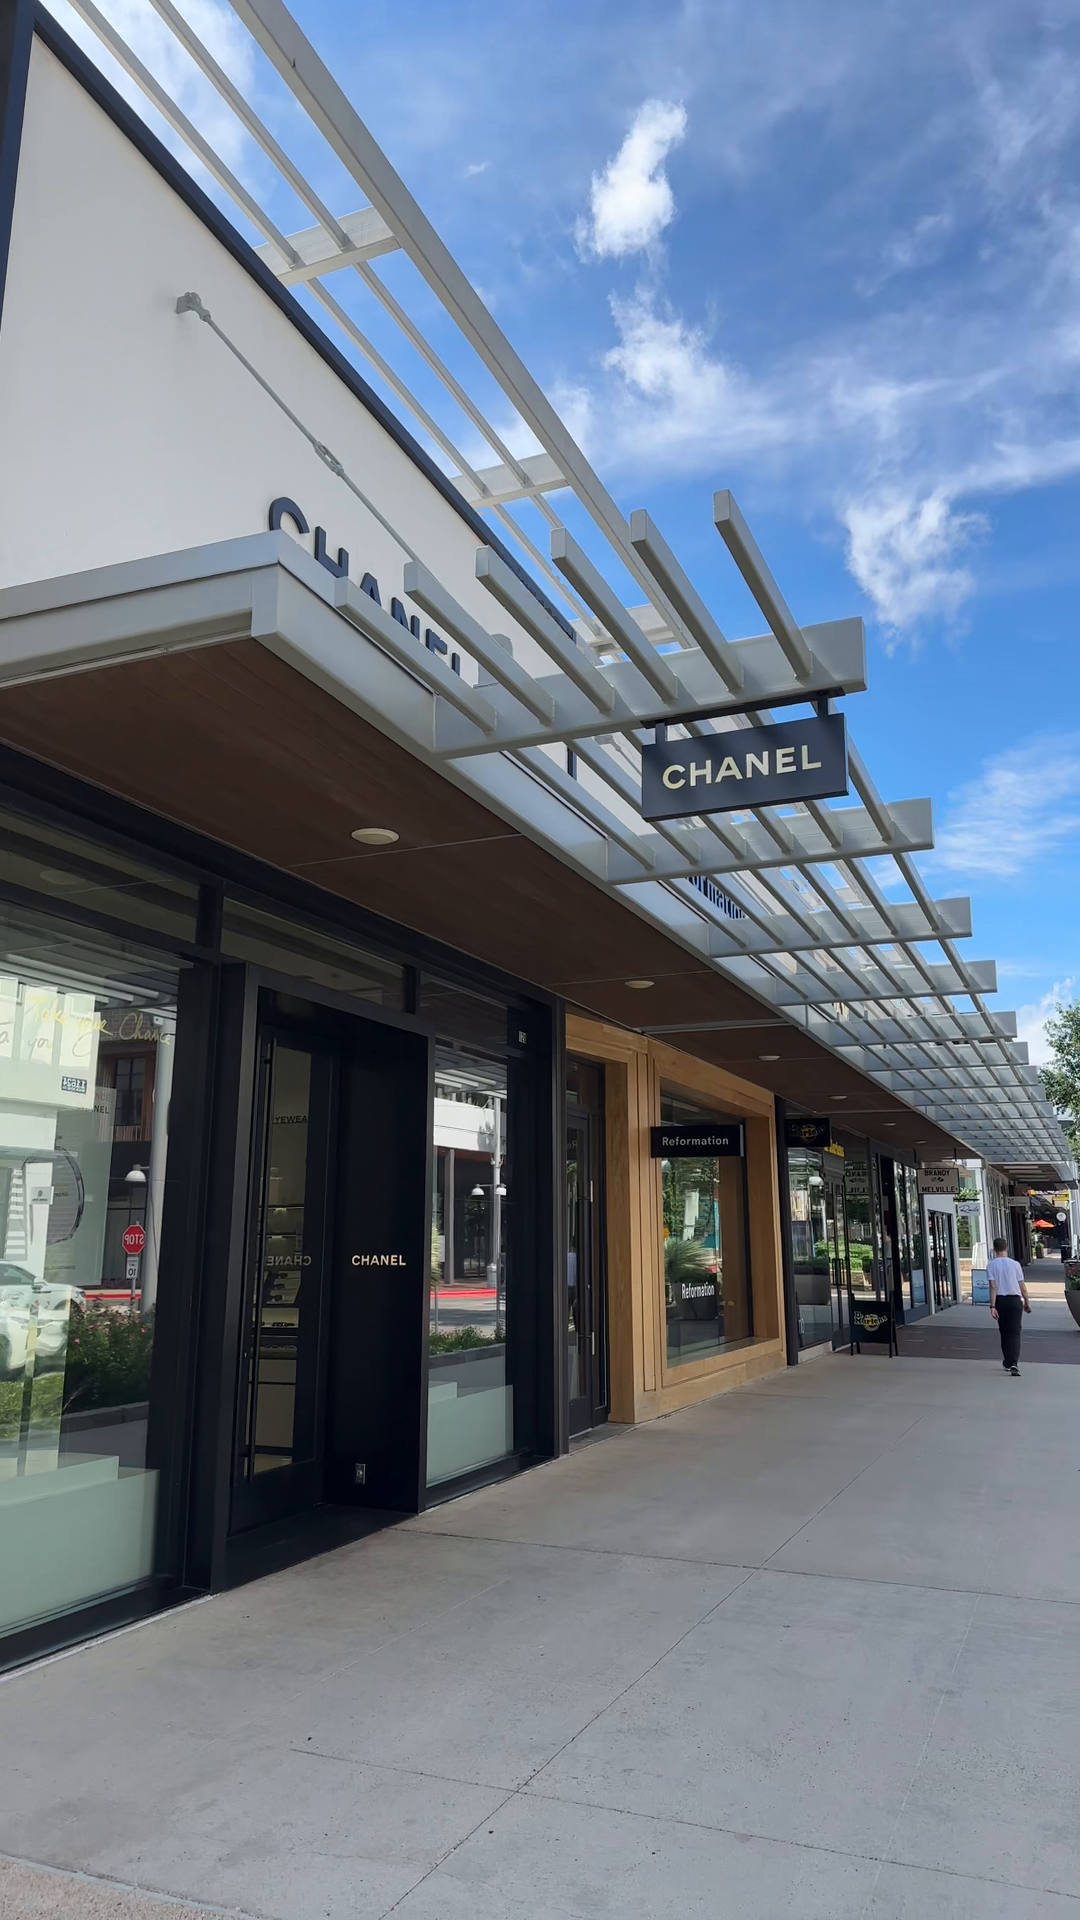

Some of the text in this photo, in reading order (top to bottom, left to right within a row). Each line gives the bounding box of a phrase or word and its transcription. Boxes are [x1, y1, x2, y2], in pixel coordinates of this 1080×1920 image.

[662, 744, 822, 790] CHANEL
[26, 995, 66, 1027] Take
[119, 1012, 171, 1045] Chance
[272, 1115, 308, 1124] YEWEA
[662, 1135, 729, 1147] Reformation
[921, 1185, 956, 1193] MELVILLE
[351, 1254, 407, 1266] CHANEL
[681, 1281, 715, 1299] Reformation
